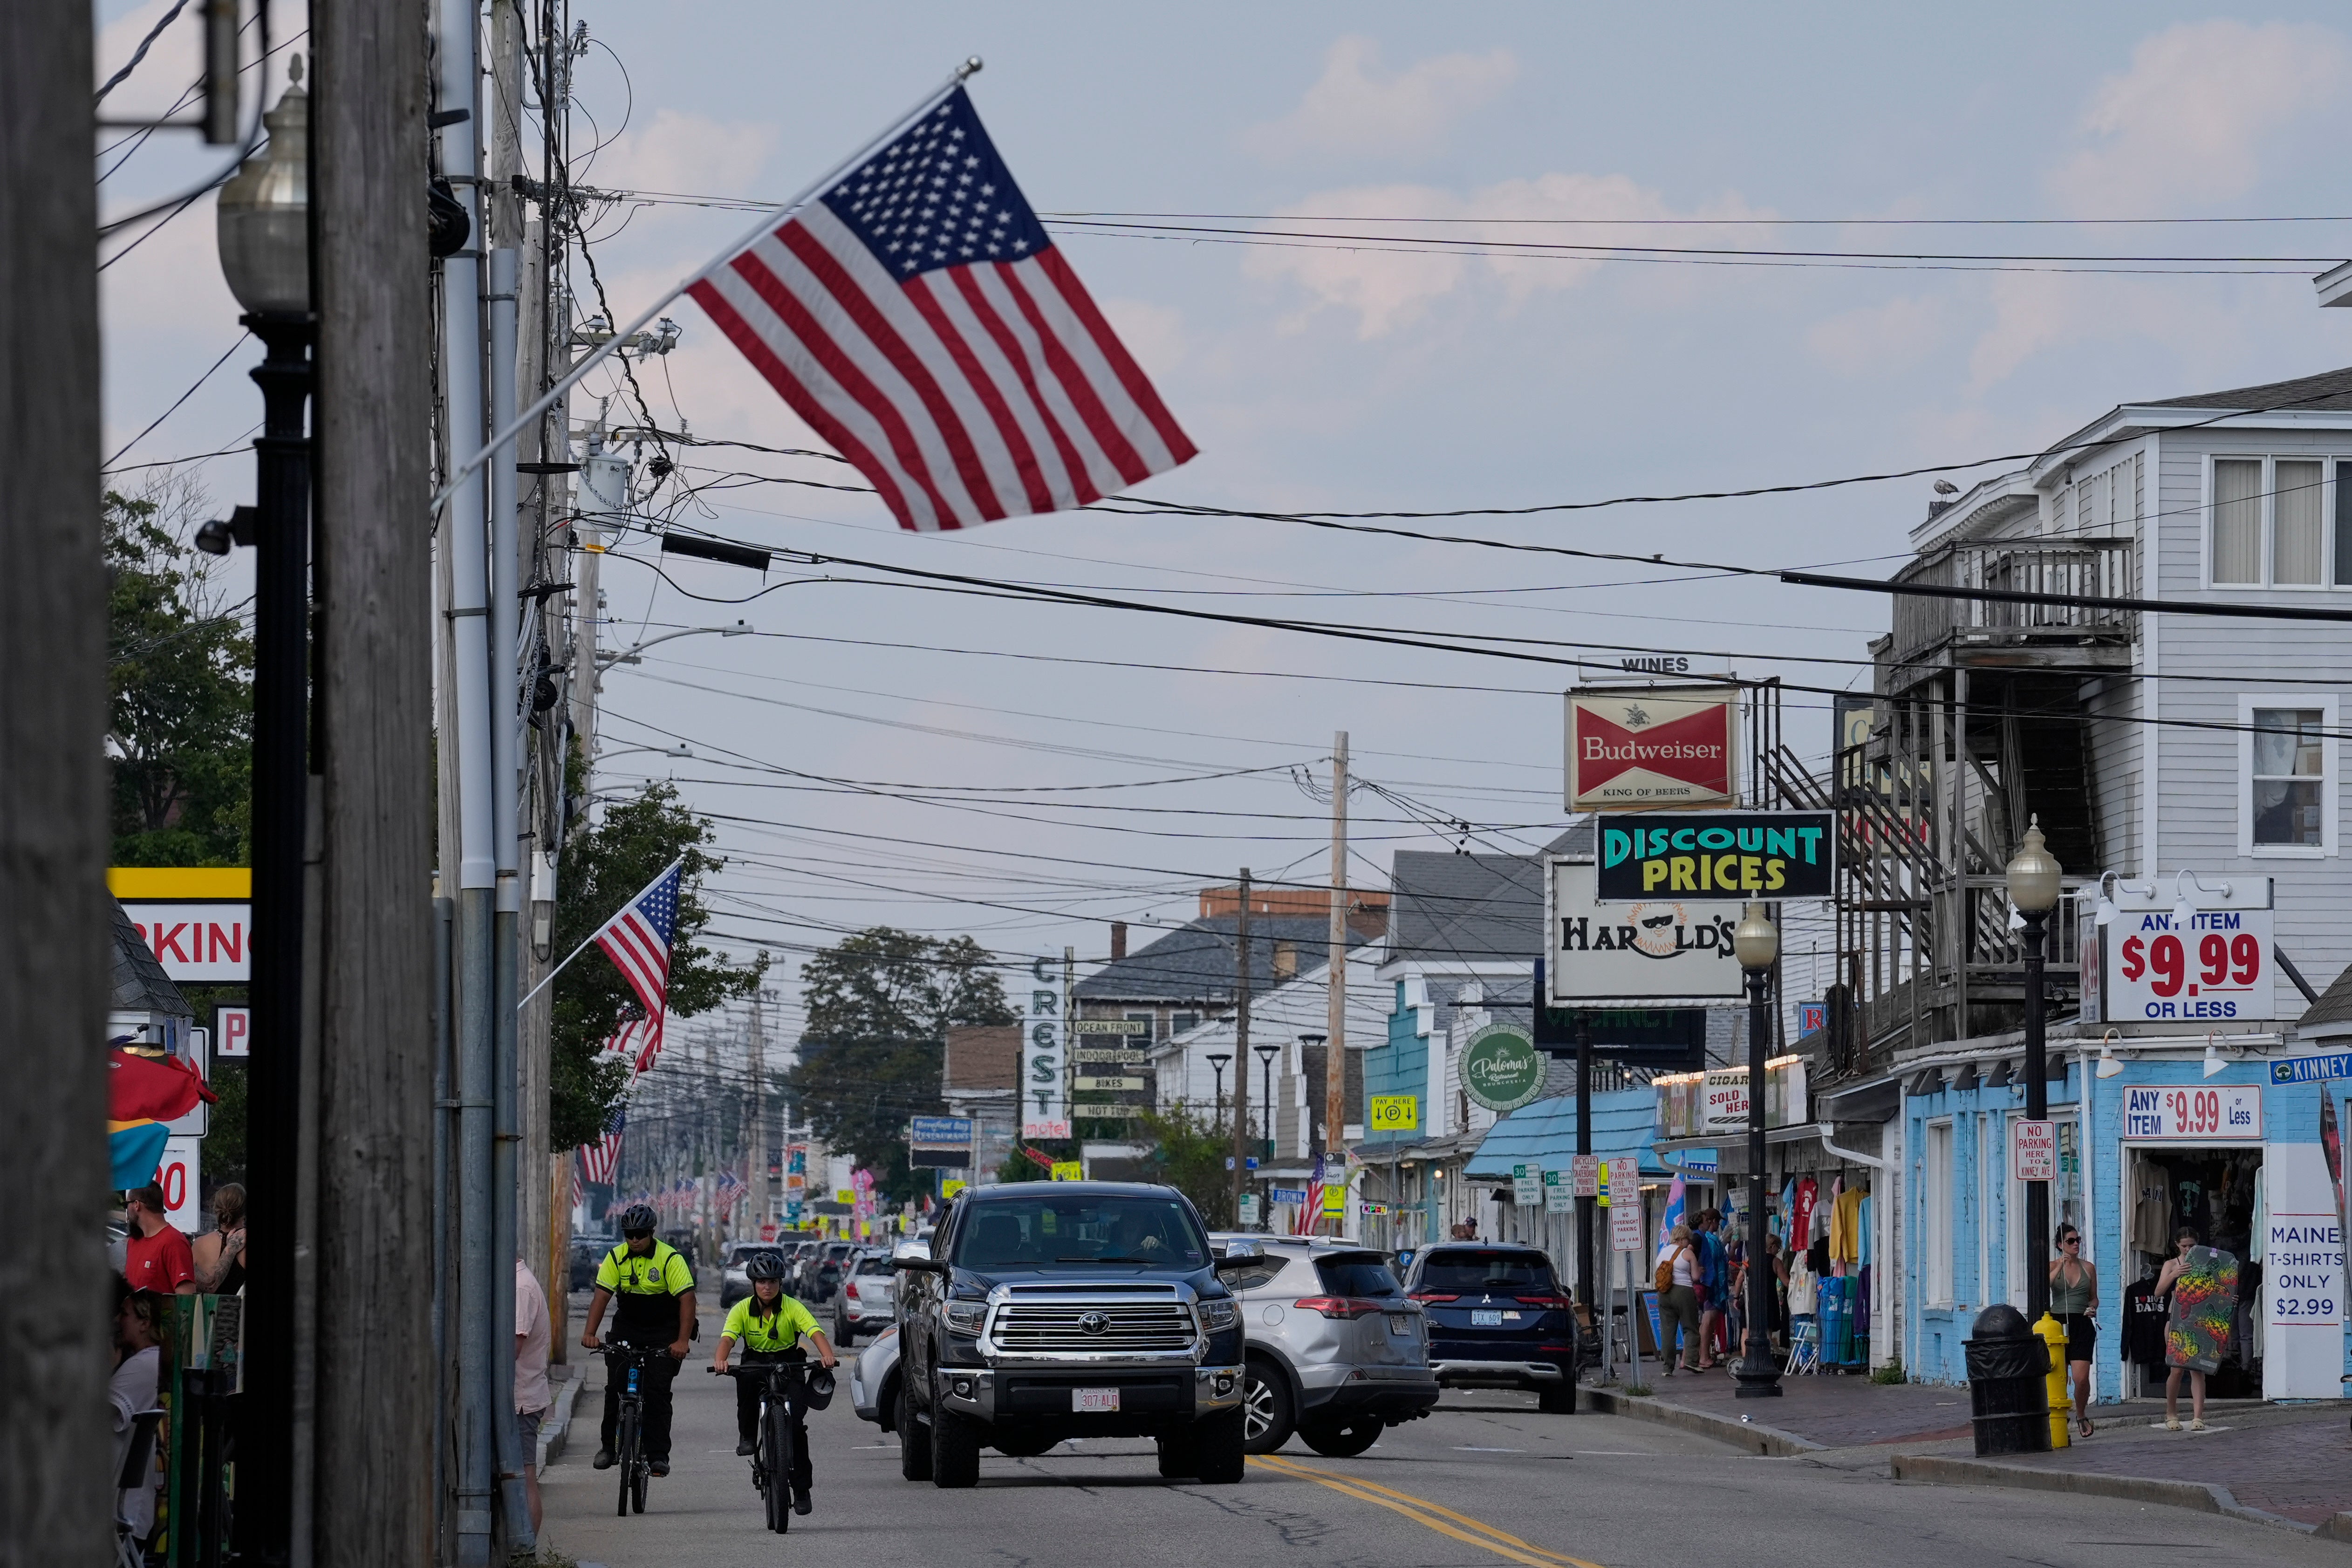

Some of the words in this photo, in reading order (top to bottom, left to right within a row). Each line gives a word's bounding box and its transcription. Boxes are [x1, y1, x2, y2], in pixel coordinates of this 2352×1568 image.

[1621, 657, 1689, 672] WINES
[1584, 737, 1721, 760] Budweiser
[1604, 828, 1822, 870] DISCOUNT
[1642, 854, 1785, 891] PRICES
[2141, 914, 2179, 931] ANY
[2192, 913, 2240, 929] ITEM
[133, 923, 251, 963] KIN
[2122, 934, 2259, 997] $9.99
[2145, 1002, 2175, 1017] OR
[2184, 1001, 2236, 1017] LESS
[226, 1013, 250, 1050] P
[1077, 1023, 1108, 1033] OCEAN
[1111, 1022, 1142, 1033] FRONT
[1032, 957, 1058, 1115] CREST
[1471, 1055, 1527, 1077] Paloma's
[2293, 1055, 2348, 1081] KINNEY
[1096, 1079, 1123, 1088] BIKES
[1709, 1075, 1749, 1086] CIGAR
[1709, 1089, 1739, 1105] SOLD
[2130, 1089, 2159, 1111] ANY
[1088, 1106, 1108, 1115] HOT
[1726, 1100, 1748, 1114] HER
[2166, 1091, 2219, 1133] $9.99
[2128, 1113, 2161, 1135] ITEM
[2229, 1107, 2250, 1125] Less
[1026, 1121, 1070, 1137] motel
[2028, 1126, 2042, 1137] NO
[2019, 1138, 2051, 1149] PARKING
[1515, 1167, 1525, 1176] 30
[1617, 1162, 1627, 1171] NO
[2021, 1166, 2038, 1177] KINNEY
[2041, 1166, 2050, 1176] AVE
[1547, 1174, 1557, 1183] 30
[1610, 1171, 1635, 1180] PARKING
[1277, 1191, 1303, 1203] BROWN
[1364, 1205, 1386, 1214] OPEN
[2272, 1227, 2340, 1243] MAINE
[2269, 1253, 2343, 1265] T-SHIRTS
[2279, 1275, 2330, 1288] ONLY
[2135, 1303, 2164, 1313] DADS
[2277, 1298, 2333, 1316] $2.99
